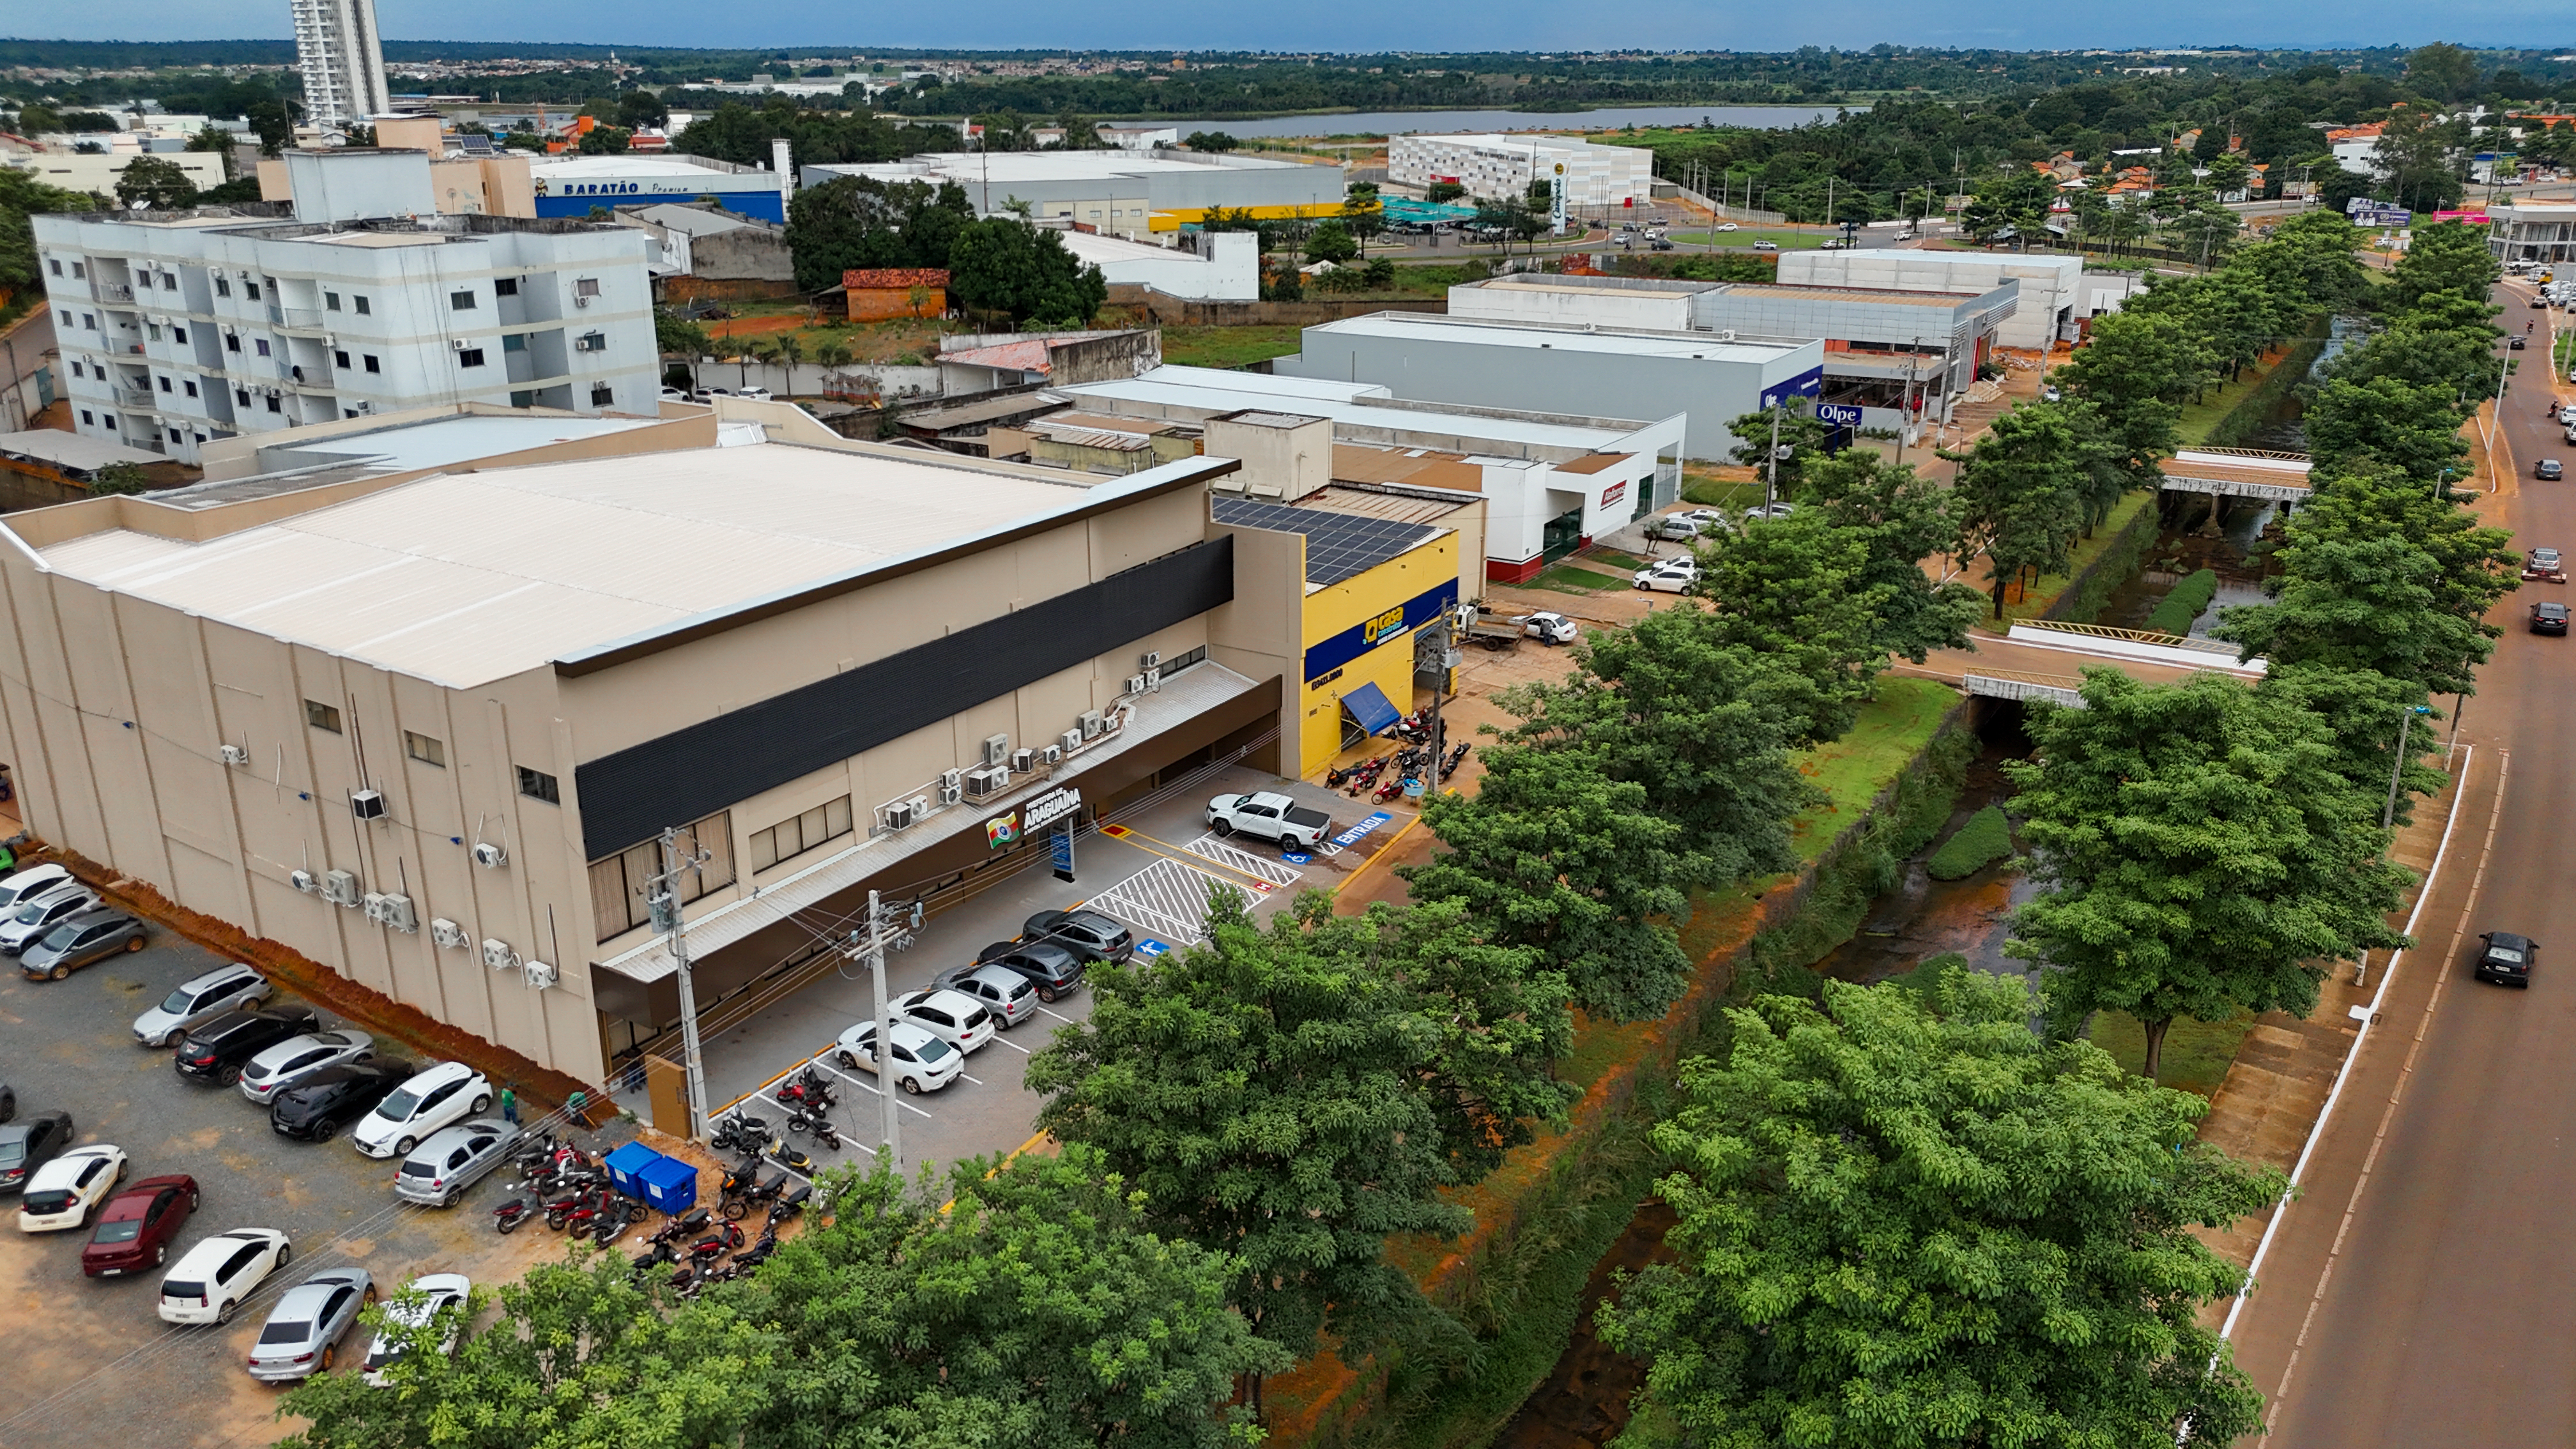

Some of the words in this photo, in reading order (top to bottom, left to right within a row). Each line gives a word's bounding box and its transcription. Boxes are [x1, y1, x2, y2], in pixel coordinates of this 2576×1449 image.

[564, 180, 639, 195] BARATÃO
[1552, 178, 1563, 218] Campelo
[1820, 405, 1857, 423] Olpe
[1379, 606, 1404, 630] casa
[1023, 788, 1081, 829] ARAGUAÍNA
[1025, 791, 1056, 811] PREFEITURA
[1055, 787, 1063, 796] DE
[1336, 816, 1386, 845] ENTRADA
